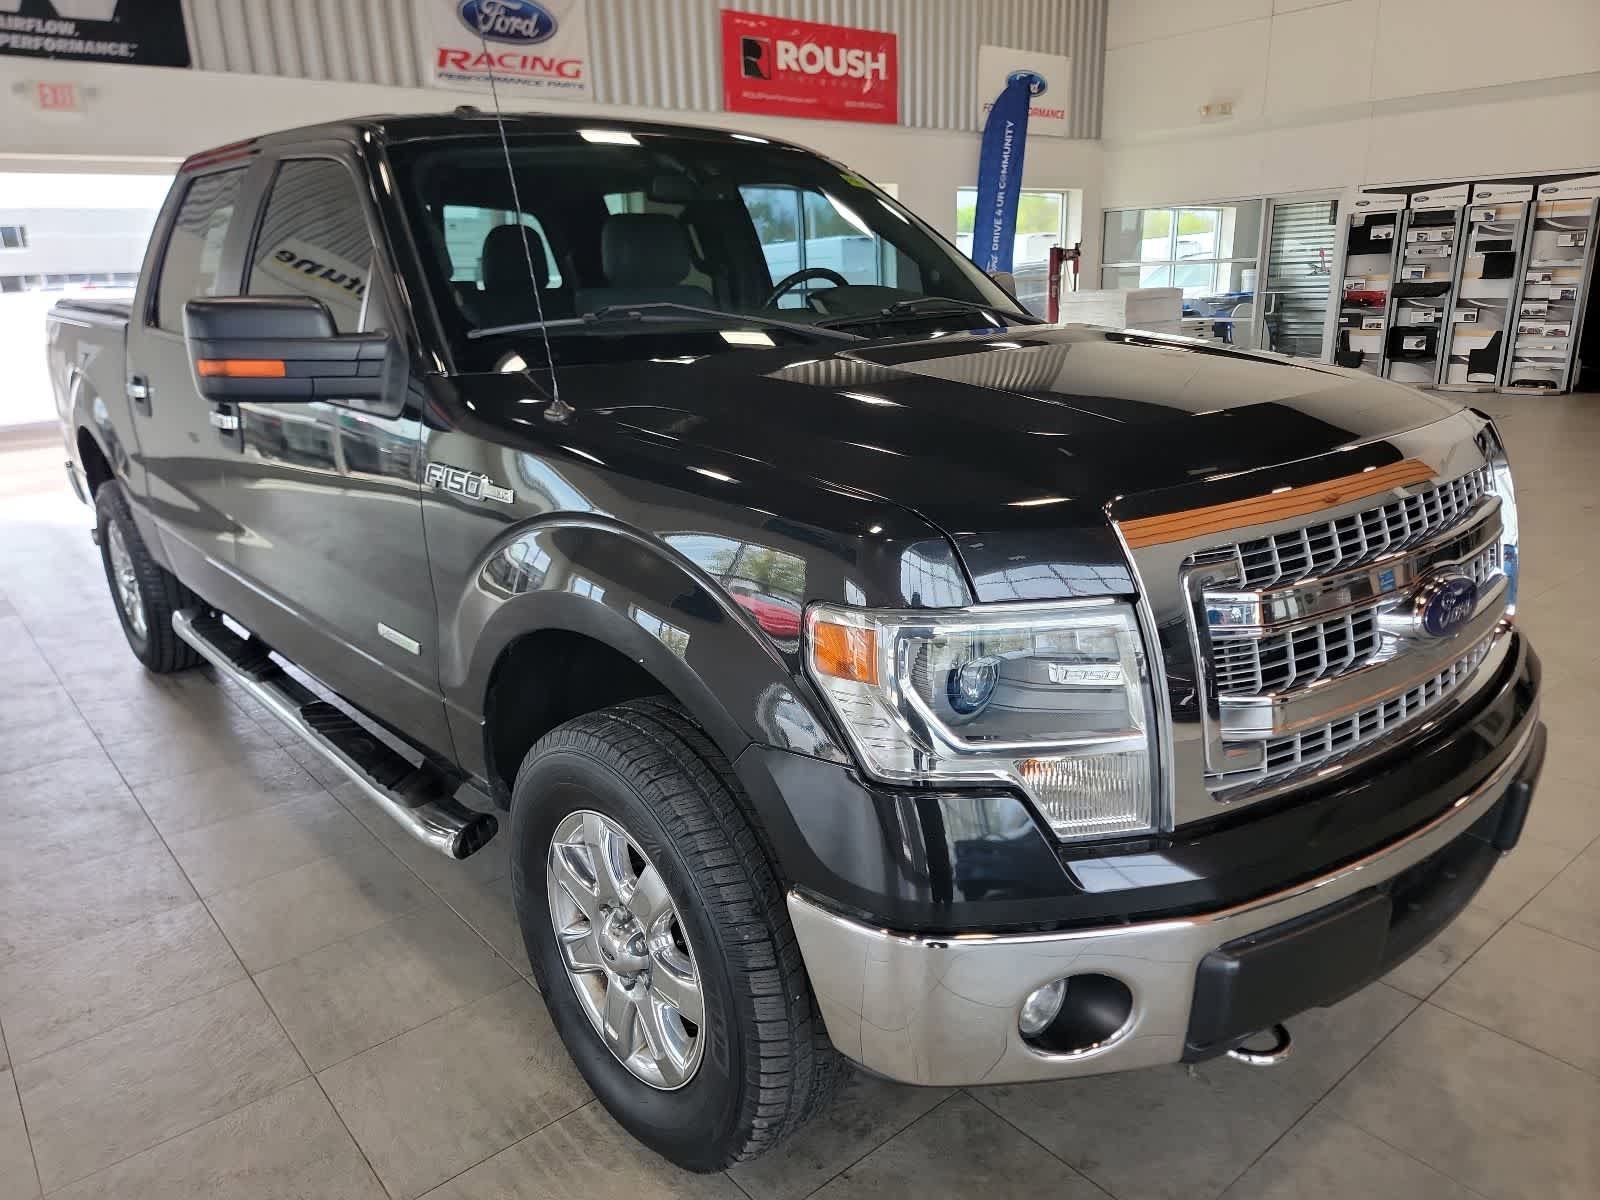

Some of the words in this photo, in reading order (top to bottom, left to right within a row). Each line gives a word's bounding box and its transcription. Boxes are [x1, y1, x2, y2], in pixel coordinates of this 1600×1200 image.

[479, 0, 540, 38] Ford
[437, 47, 584, 79] RACING
[776, 39, 887, 81] ROUSH
[38, 82, 75, 110] EXIT
[438, 72, 545, 88] PERFORMANCE
[998, 120, 1016, 189] COMMUNITY
[997, 191, 1006, 208] UR
[991, 216, 1001, 251] DRIVE
